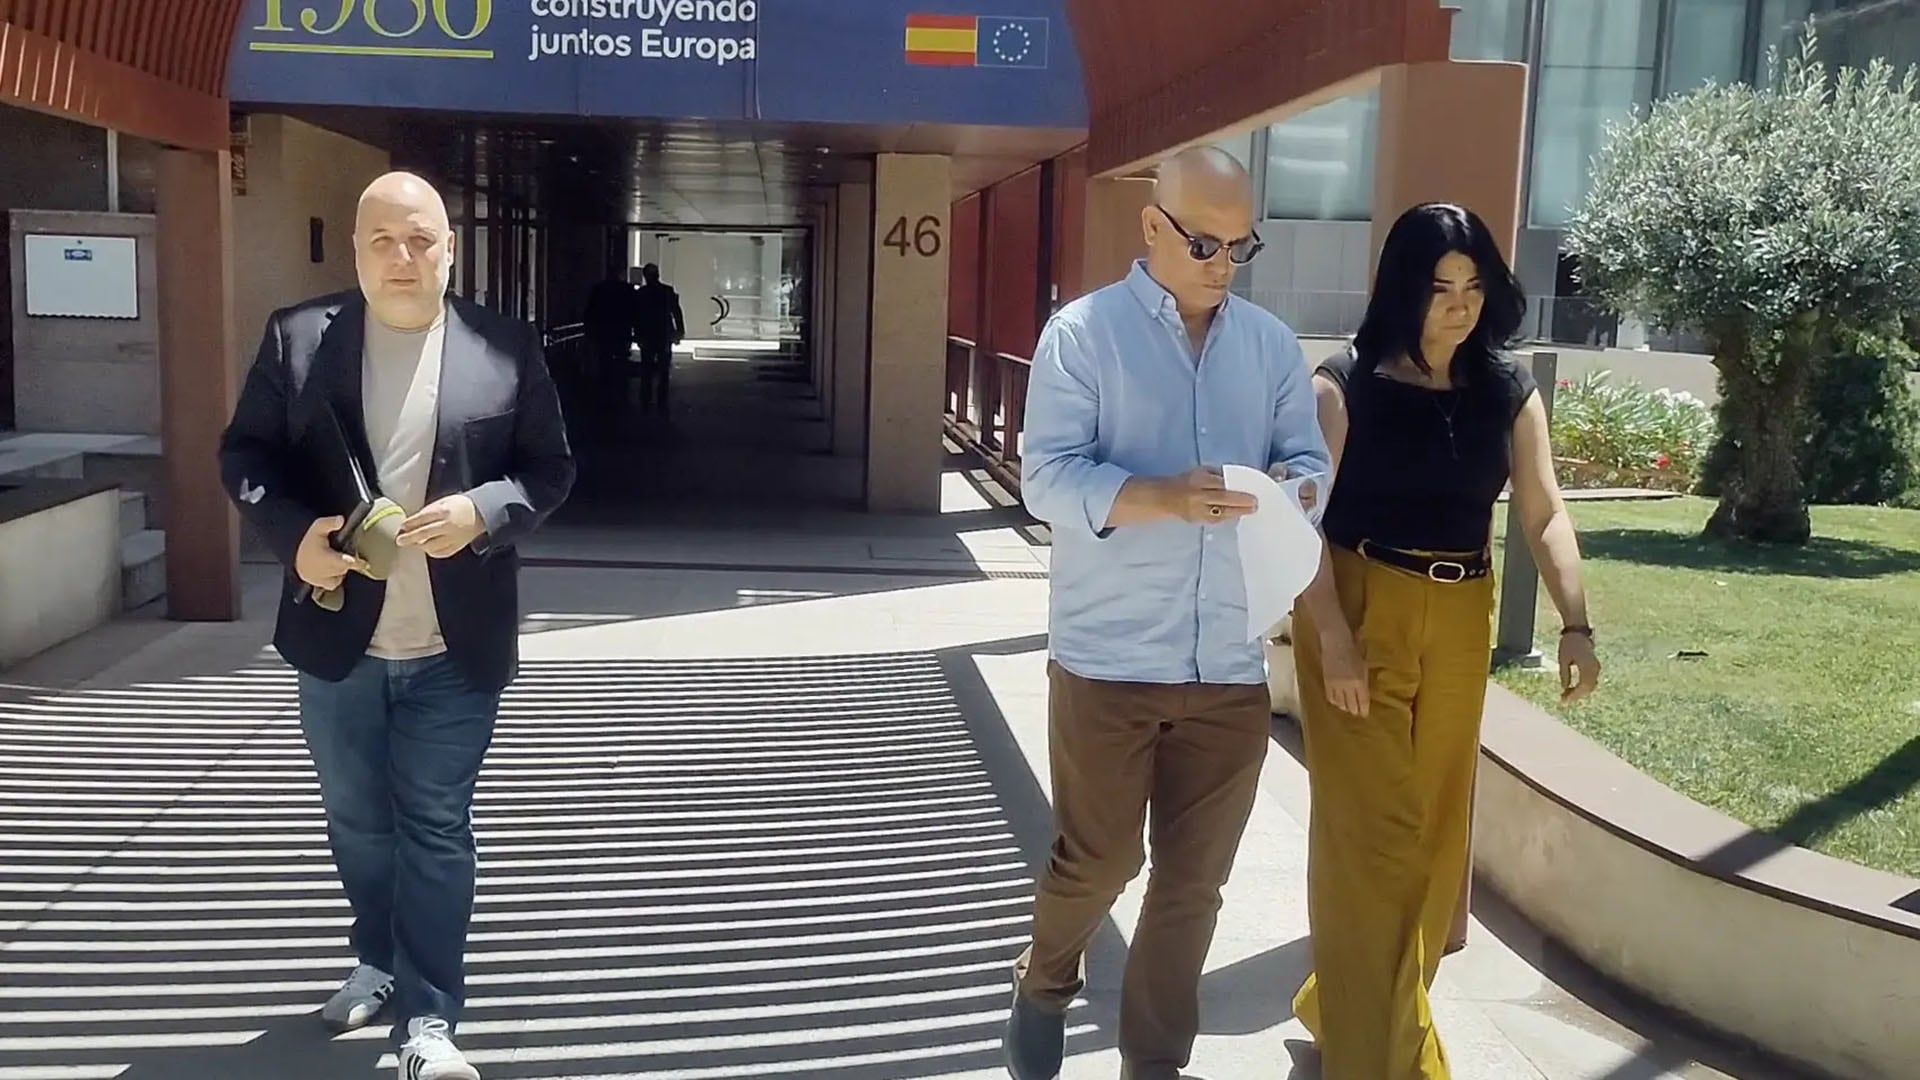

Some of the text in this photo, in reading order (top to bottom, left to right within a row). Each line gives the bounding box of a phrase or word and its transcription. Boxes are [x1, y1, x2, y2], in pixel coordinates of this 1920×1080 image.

[528, 25, 756, 66] juntos Europa
[883, 214, 941, 257] 46
